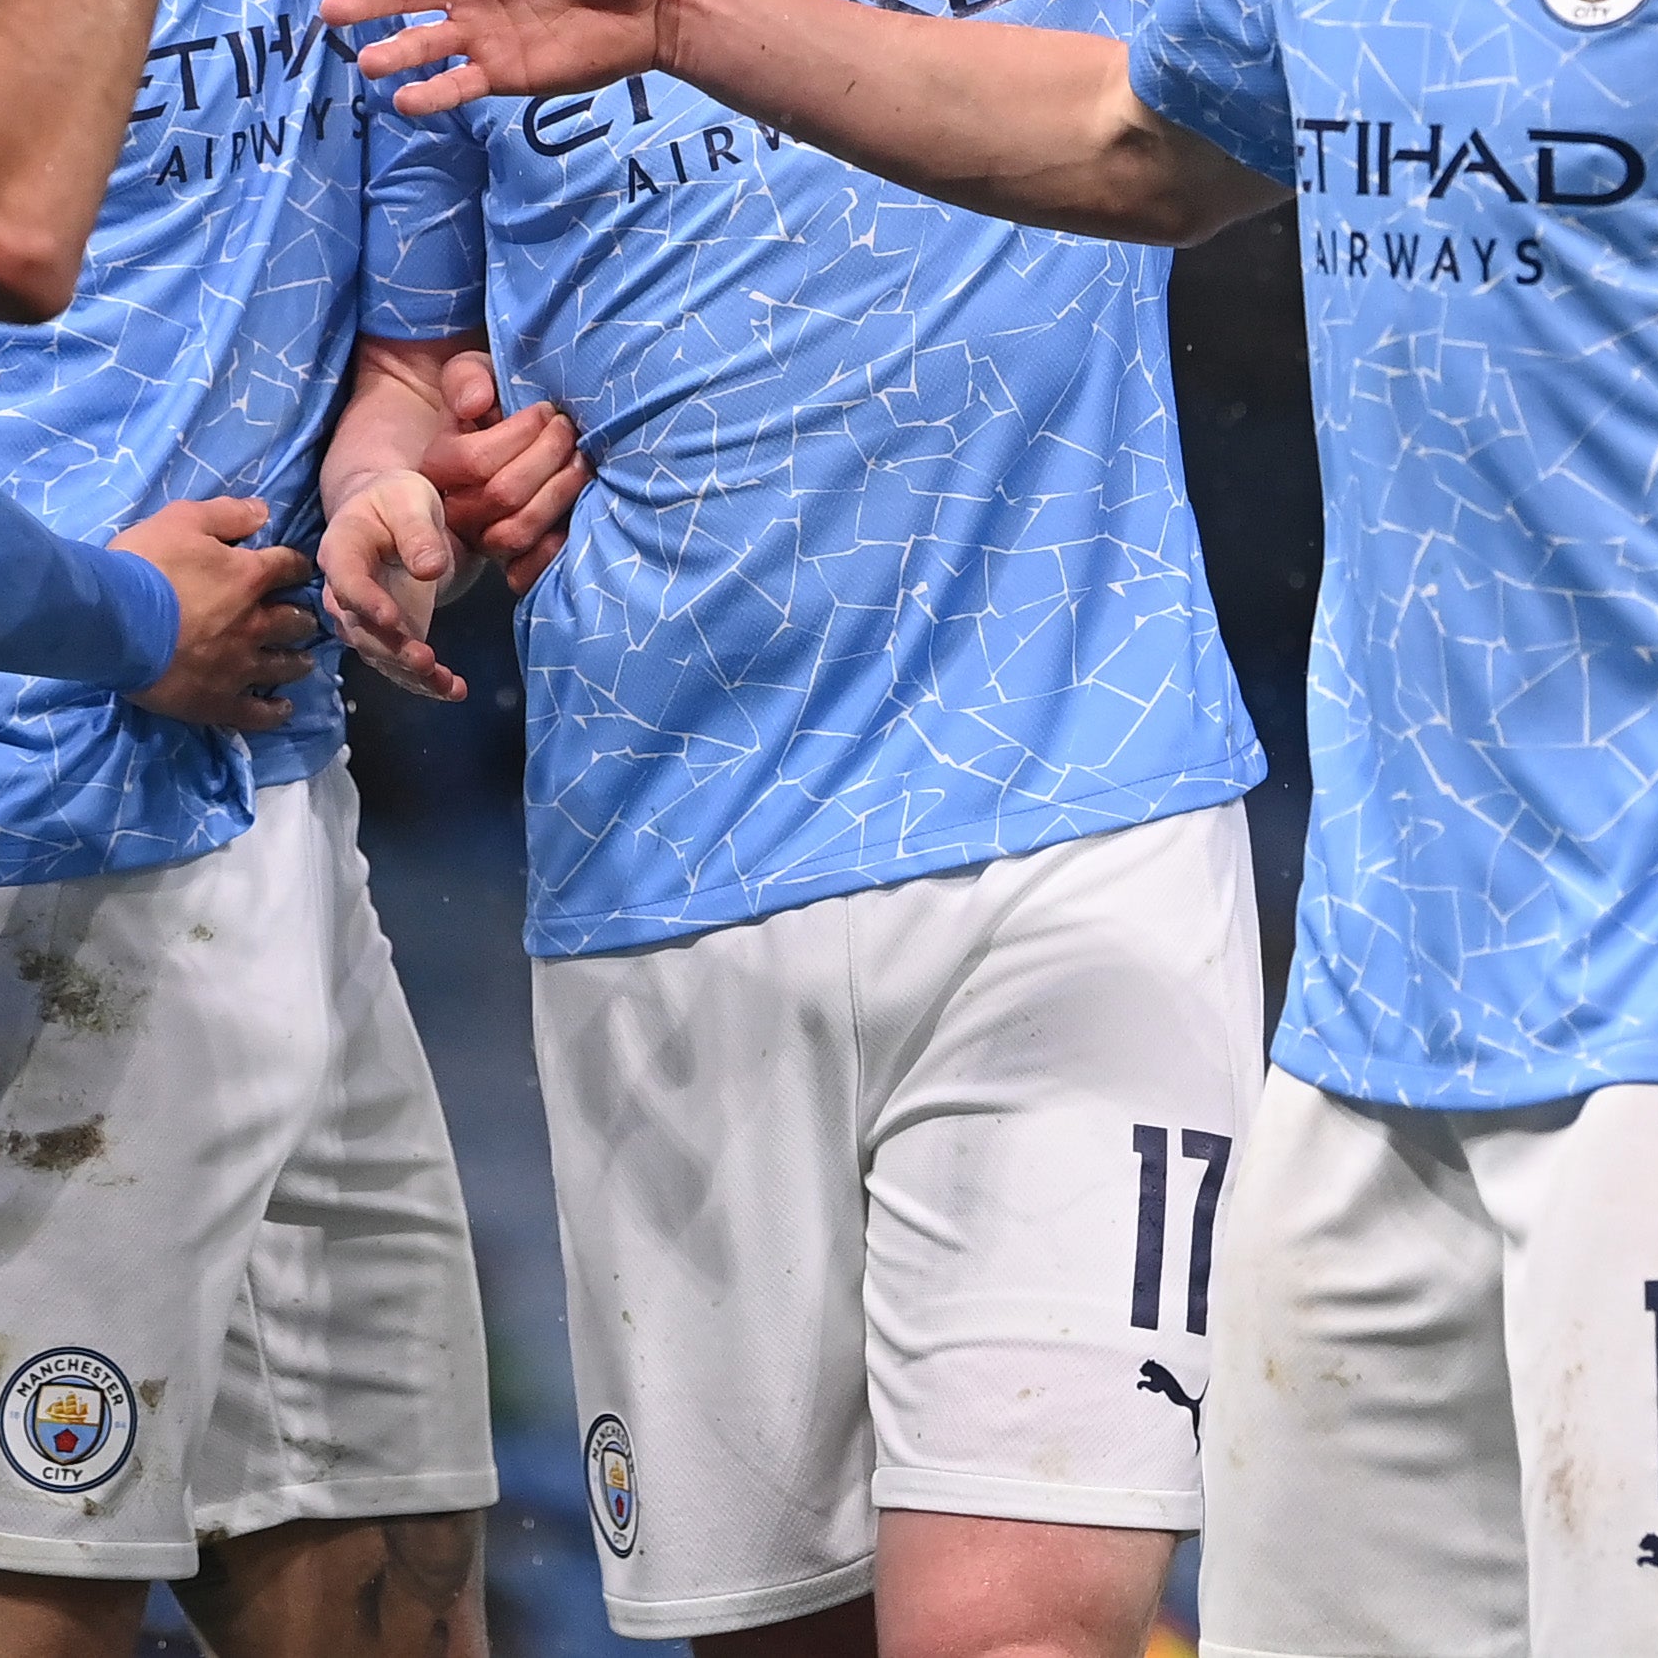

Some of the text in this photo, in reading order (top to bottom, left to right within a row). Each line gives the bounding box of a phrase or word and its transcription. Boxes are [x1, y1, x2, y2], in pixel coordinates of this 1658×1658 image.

[129, 14, 359, 122] ETIHA
[156, 94, 368, 186] AIRWYS
[1314, 229, 1543, 286] AIRWAYS
[1129, 1123, 1232, 1337] 17
[16, 1358, 124, 1406] MANCHESTER
[42, 1466, 83, 1482] CITY
